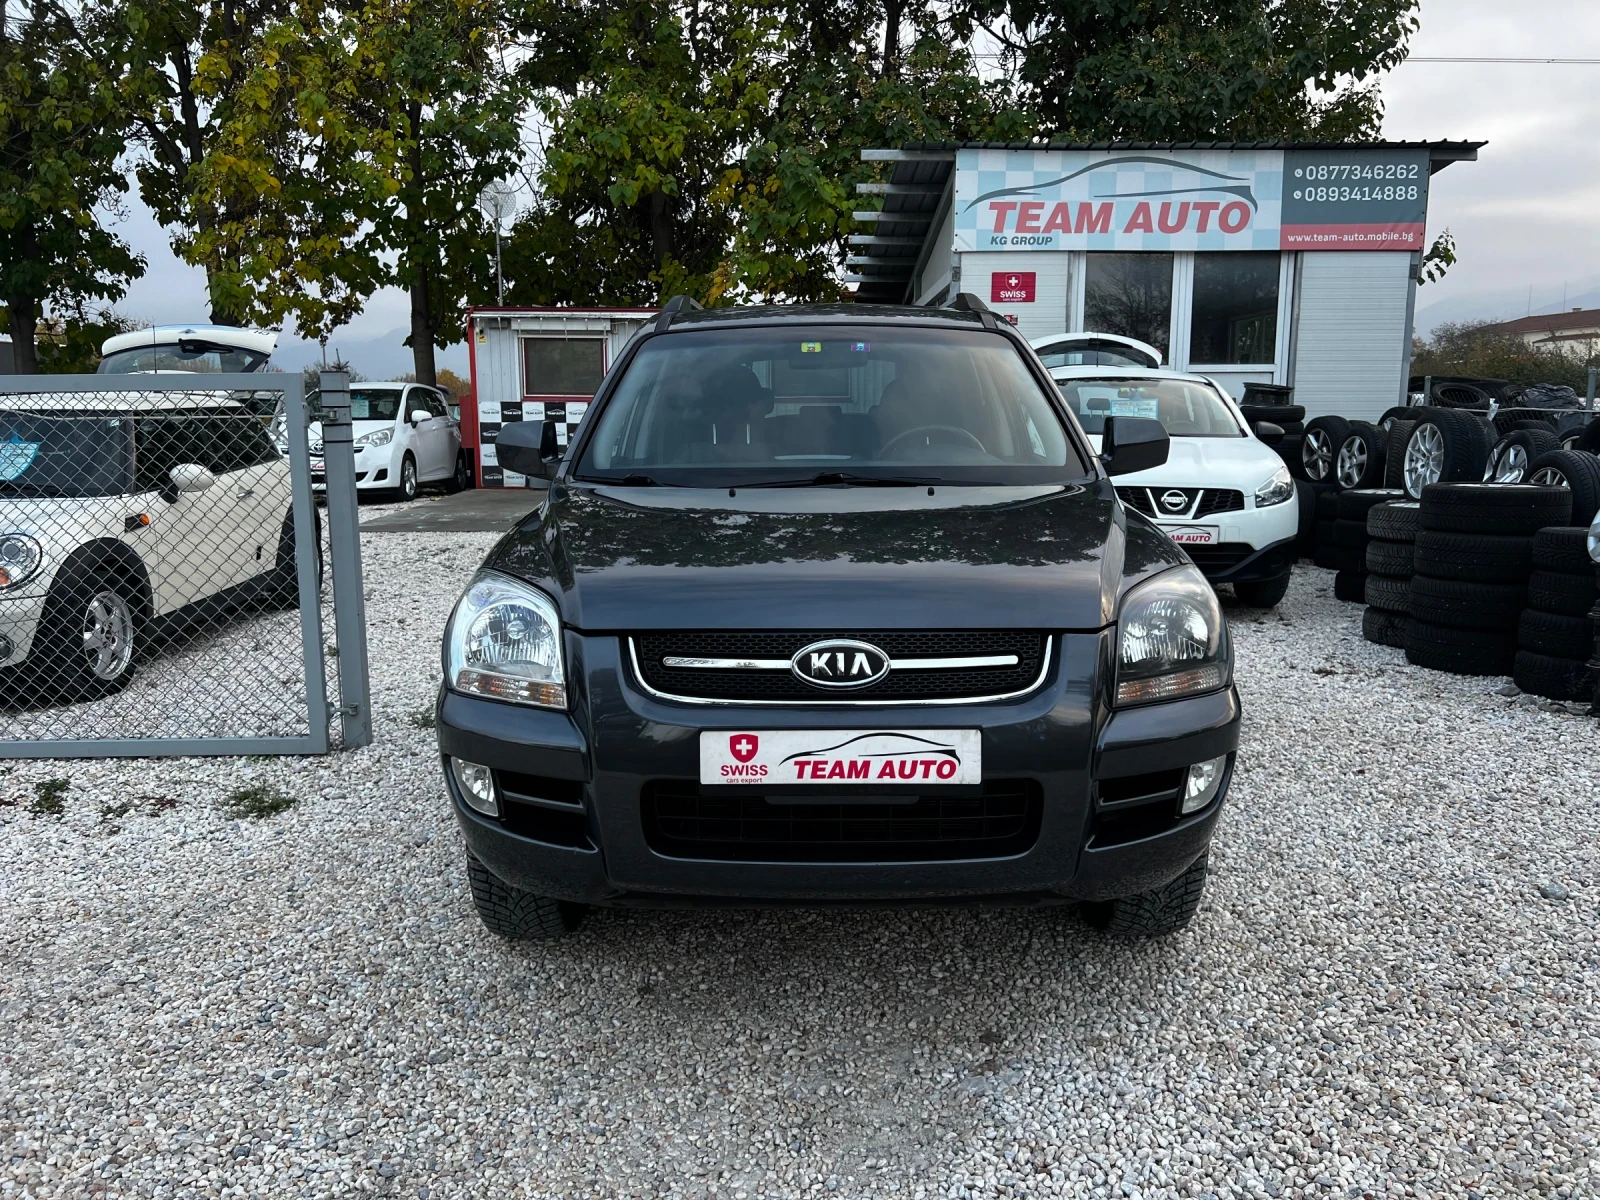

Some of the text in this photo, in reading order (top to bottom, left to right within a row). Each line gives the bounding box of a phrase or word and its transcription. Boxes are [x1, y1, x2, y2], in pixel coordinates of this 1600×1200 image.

[1305, 165, 1418, 180] 0877346262
[1304, 186, 1418, 201] 0893414888
[989, 200, 1251, 234] TEAM AUTO
[990, 236, 1053, 246] KG GROUP
[1287, 231, 1414, 243] www.team-auto.mobile.bg
[810, 652, 873, 677] KIA
[720, 764, 768, 776] SWISS
[794, 760, 957, 780] TEAM AUTO
